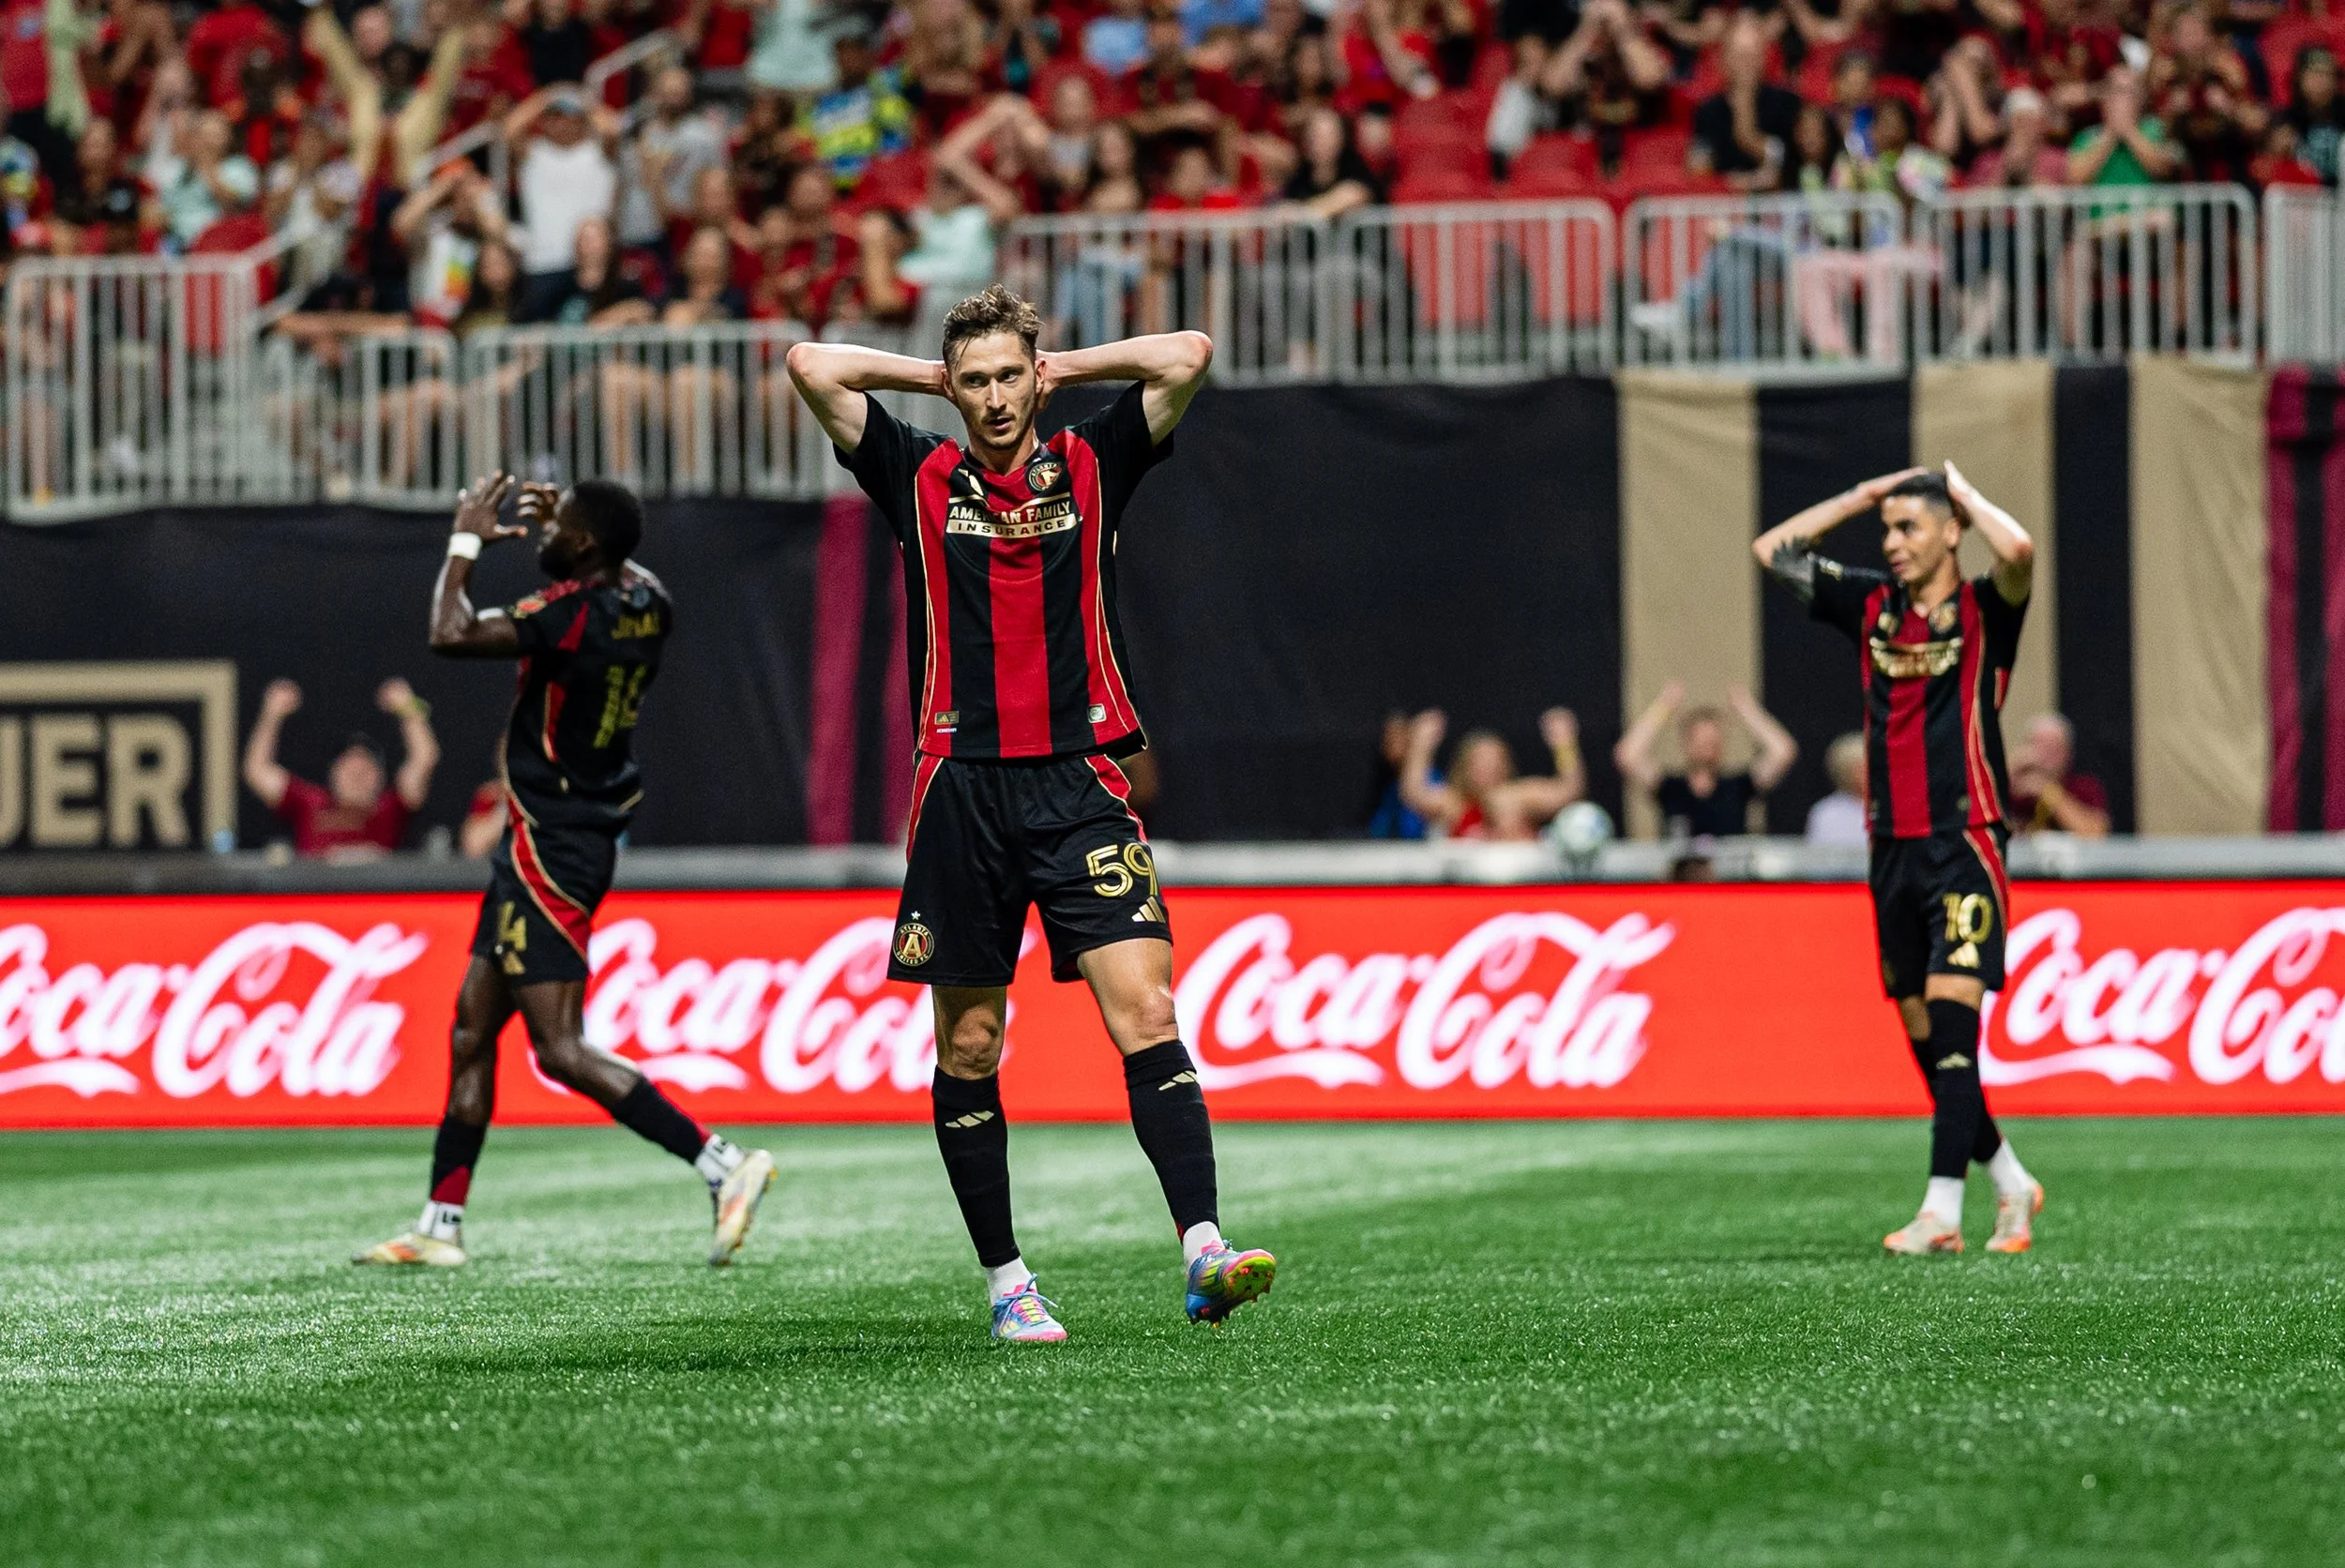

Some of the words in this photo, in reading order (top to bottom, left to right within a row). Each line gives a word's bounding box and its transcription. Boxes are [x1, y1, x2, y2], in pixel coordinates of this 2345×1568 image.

[1026, 501, 1070, 522] FAMILY
[958, 519, 1066, 536] INSURANCE
[1085, 842, 1158, 897] 59
[900, 925, 929, 936] ATLANTA
[1942, 892, 1992, 944] 10
[902, 933, 922, 958] A
[1172, 911, 1676, 1090] Coca-Cola
